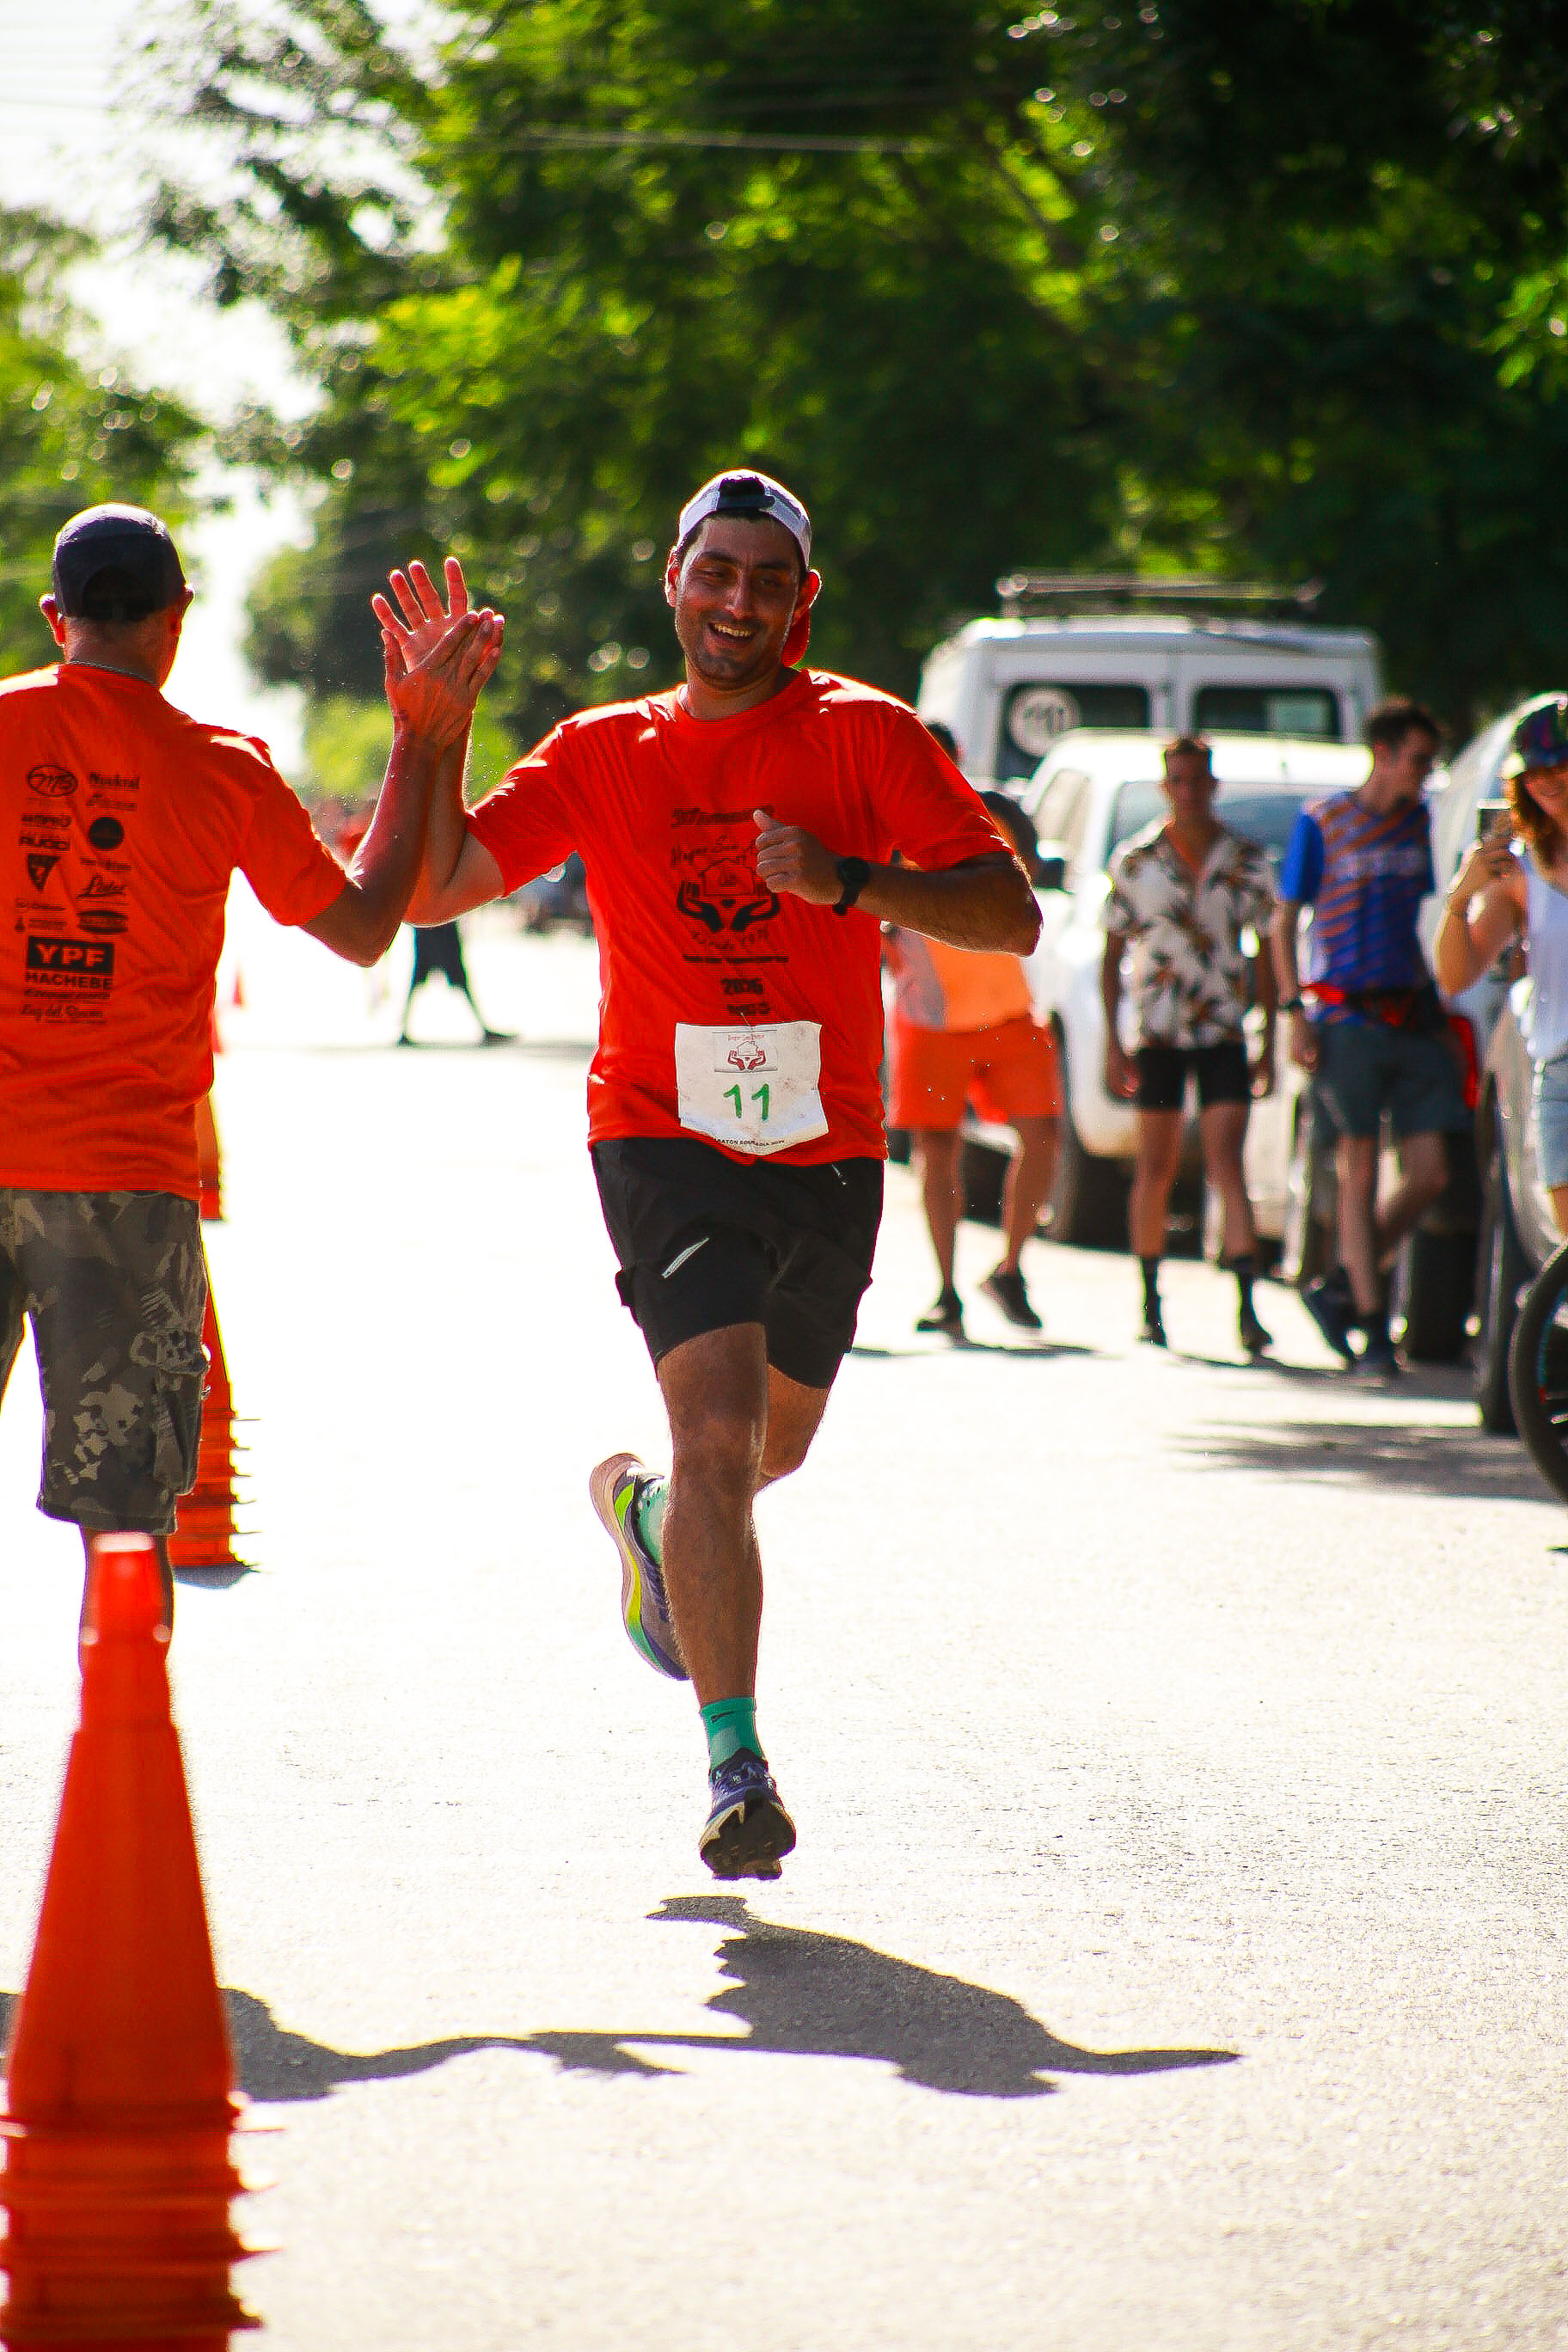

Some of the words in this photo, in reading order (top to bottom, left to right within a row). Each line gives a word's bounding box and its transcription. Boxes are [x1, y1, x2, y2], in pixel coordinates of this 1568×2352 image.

[36, 944, 104, 967] YPF
[25, 972, 113, 990] HACHEBE
[723, 1083, 769, 1121] 11
